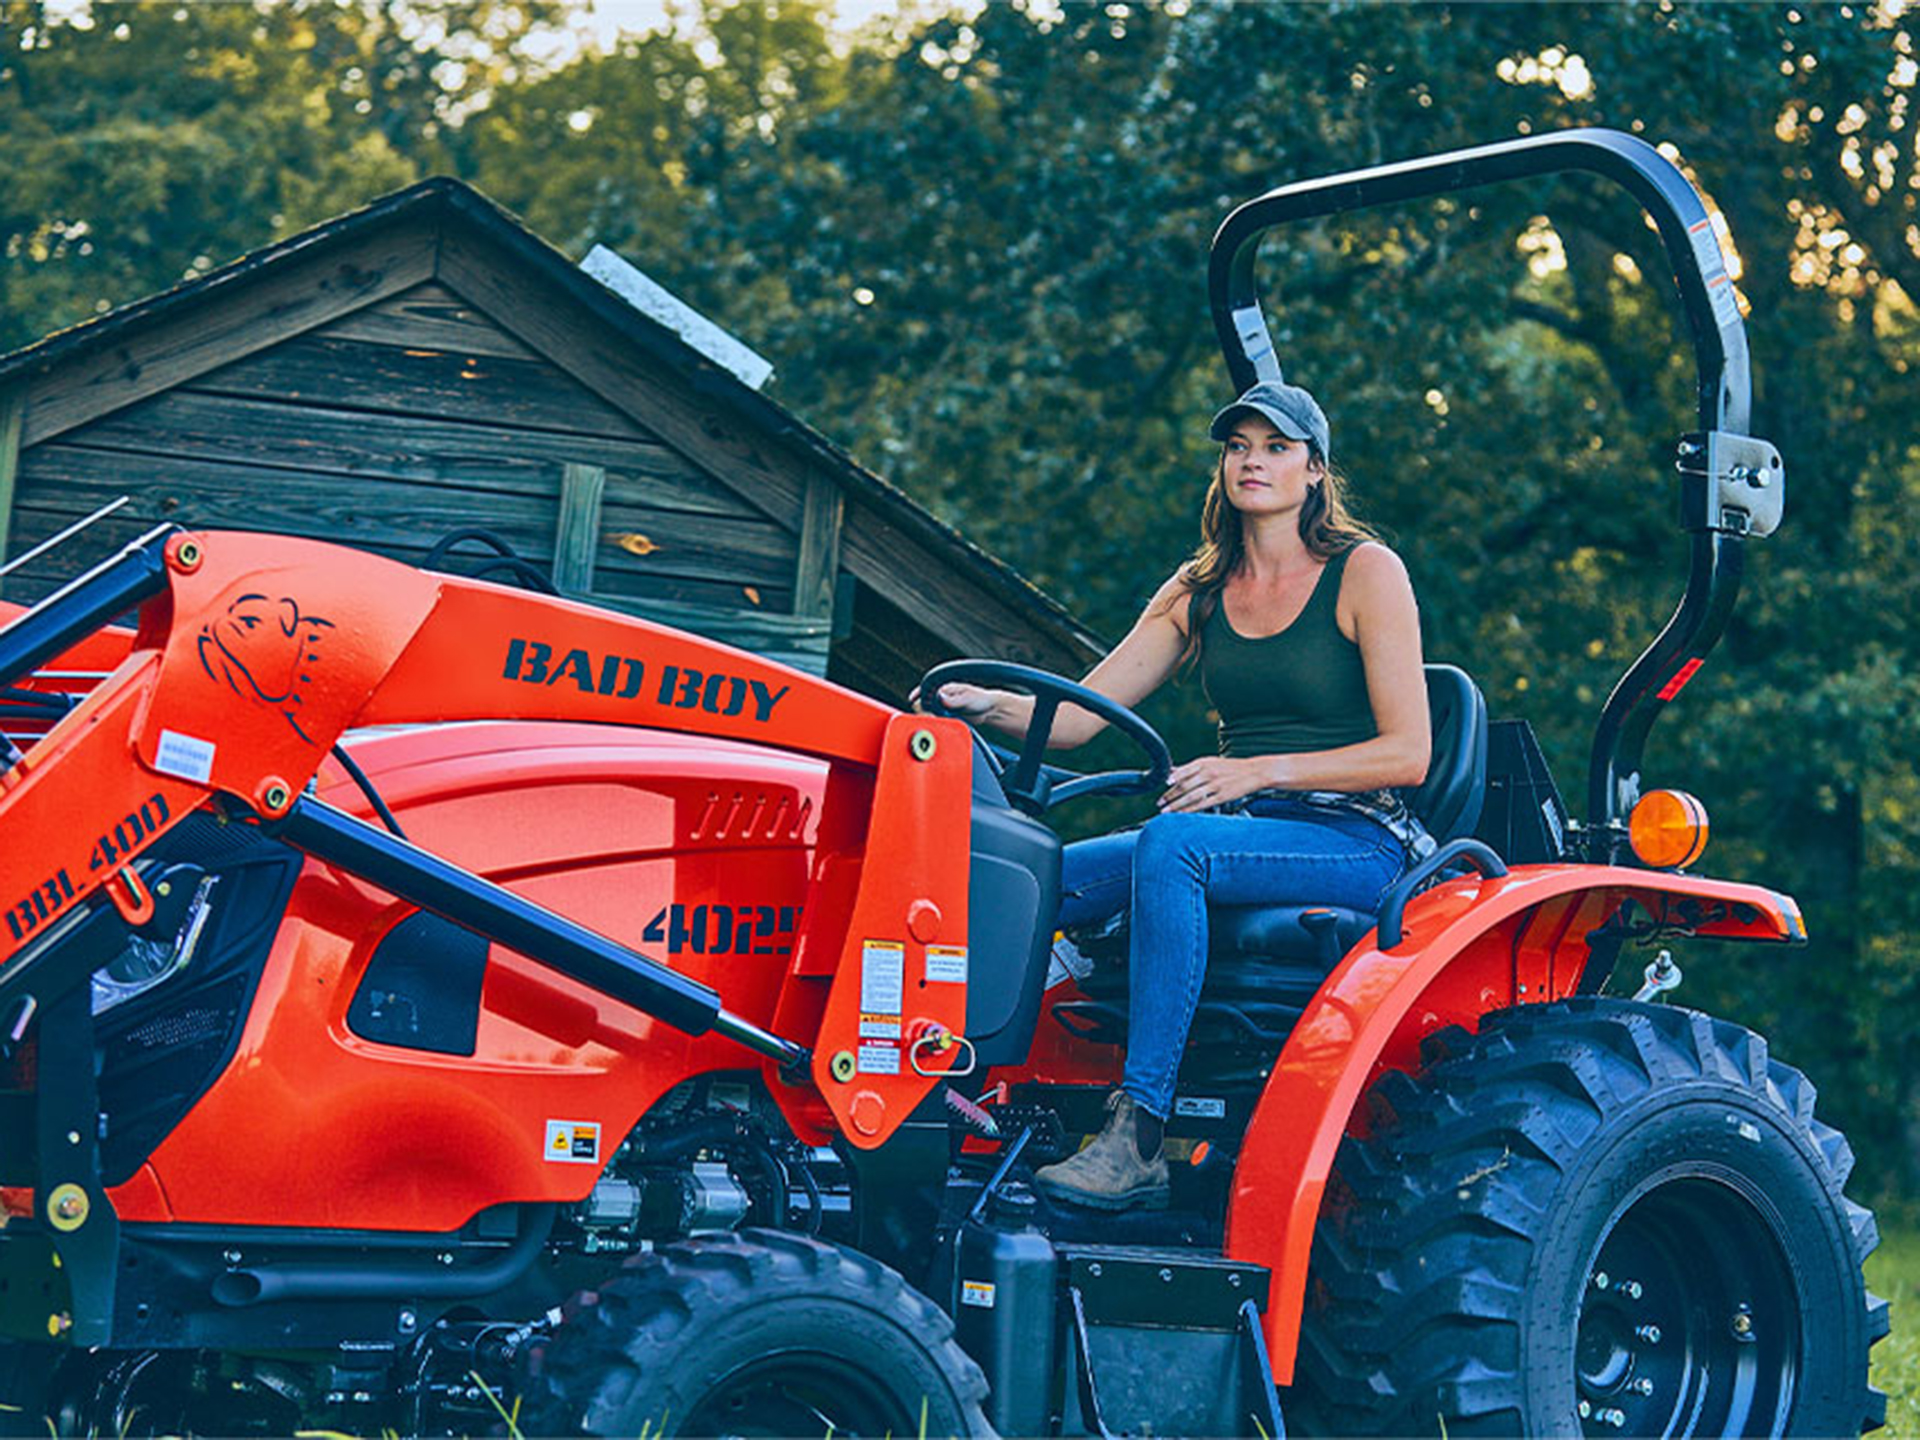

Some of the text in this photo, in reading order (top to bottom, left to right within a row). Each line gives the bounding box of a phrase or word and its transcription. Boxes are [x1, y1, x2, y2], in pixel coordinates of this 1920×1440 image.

[502, 638, 790, 722] BAD BOY
[5, 793, 170, 941] BBL 400
